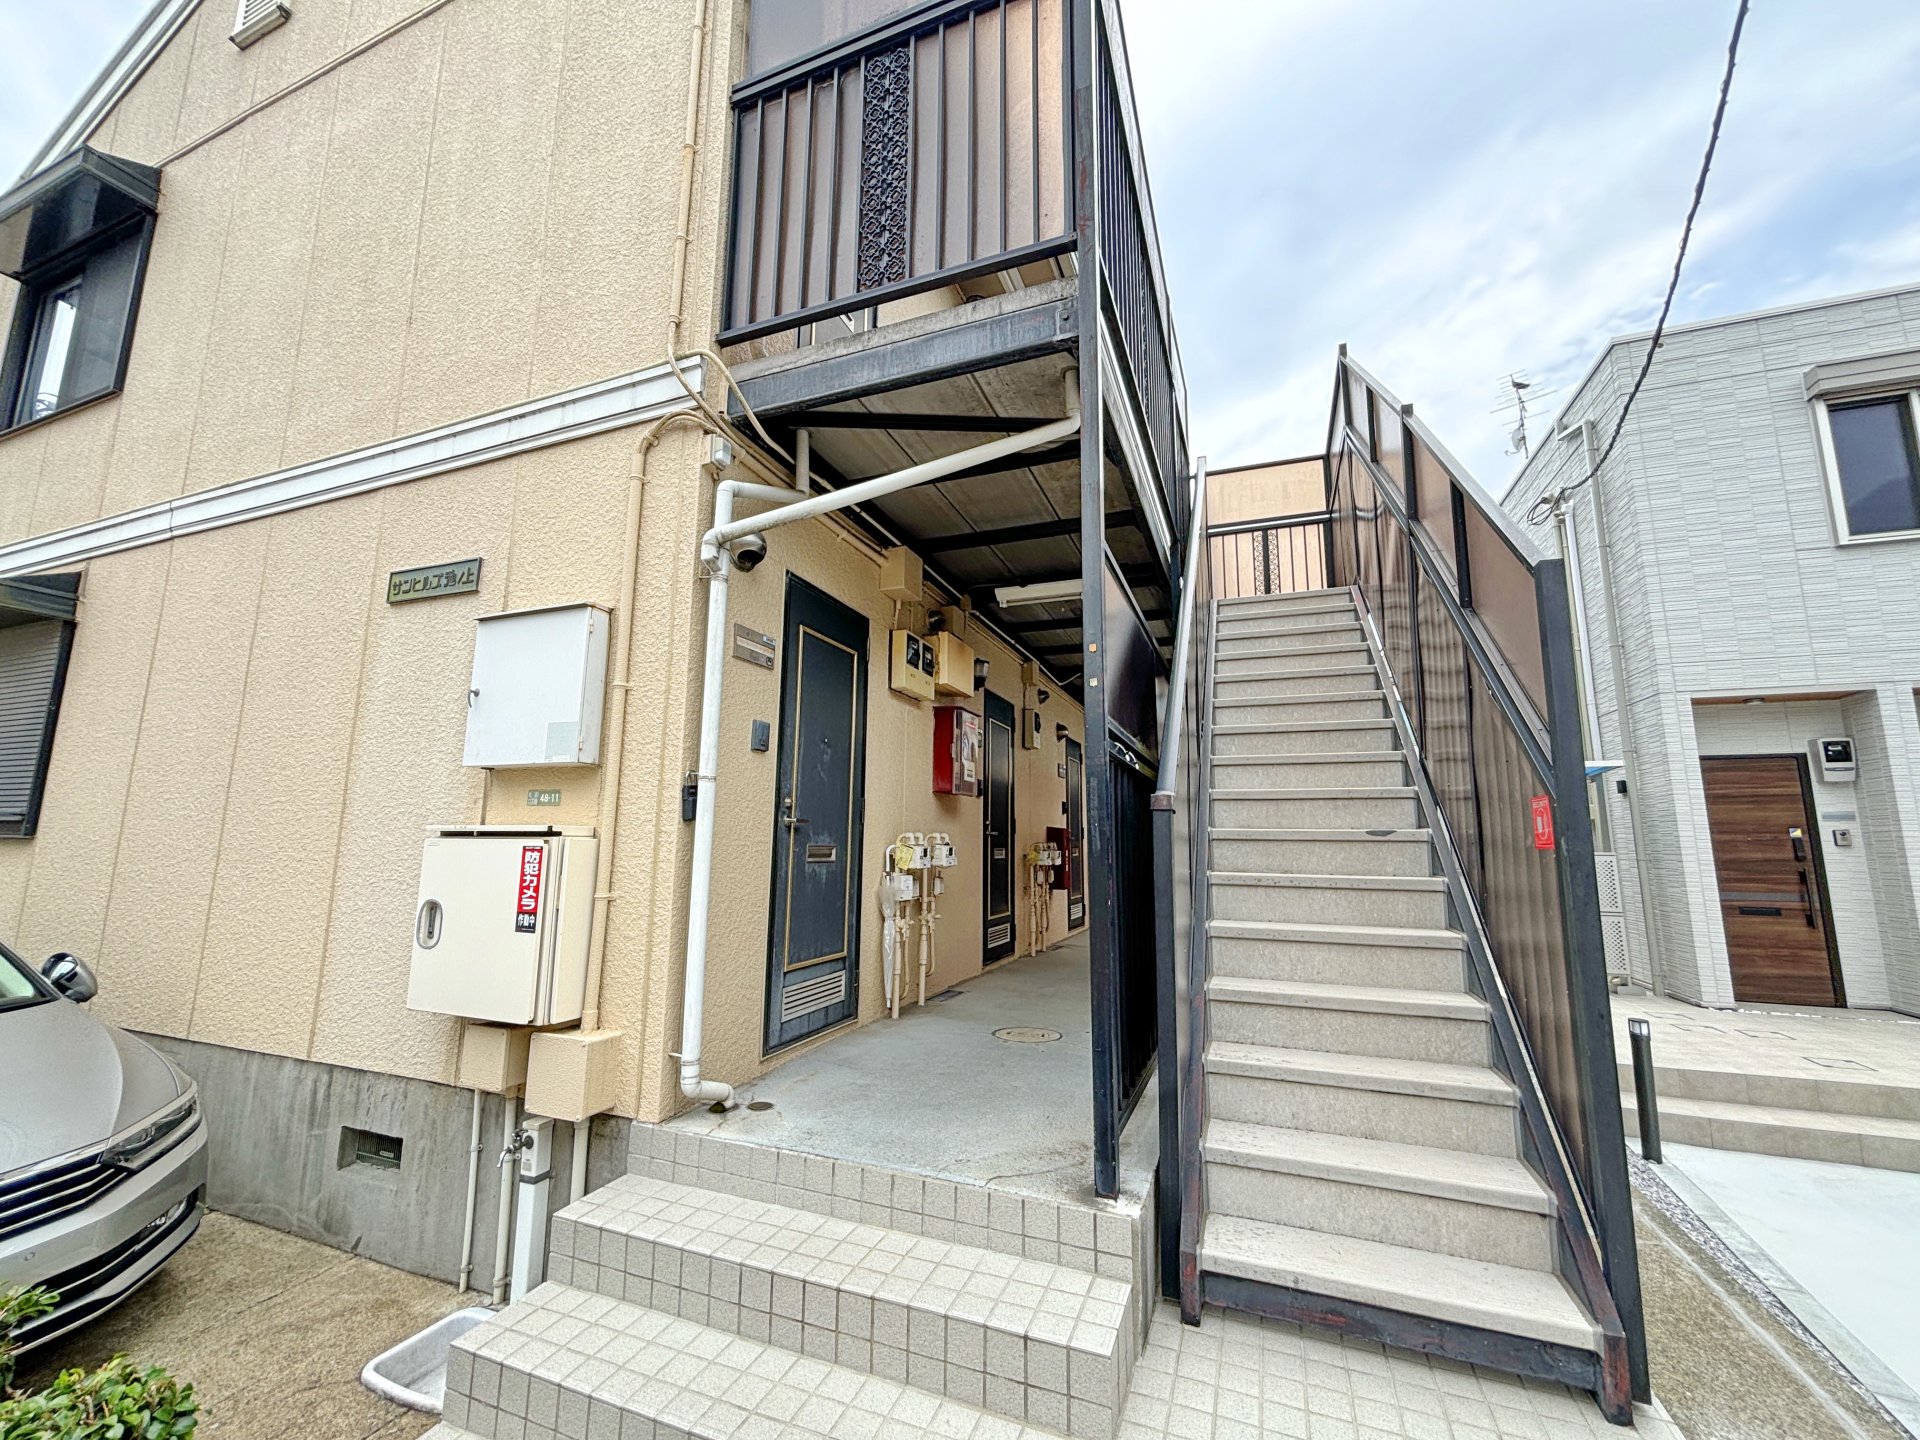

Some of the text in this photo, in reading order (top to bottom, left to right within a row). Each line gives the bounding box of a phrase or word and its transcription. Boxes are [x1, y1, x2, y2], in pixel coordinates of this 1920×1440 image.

[392, 566, 475, 596] サンヒルズ池ノ上
[520, 850, 541, 910] 防犯カメラ
[517, 913, 535, 927] 作動中
